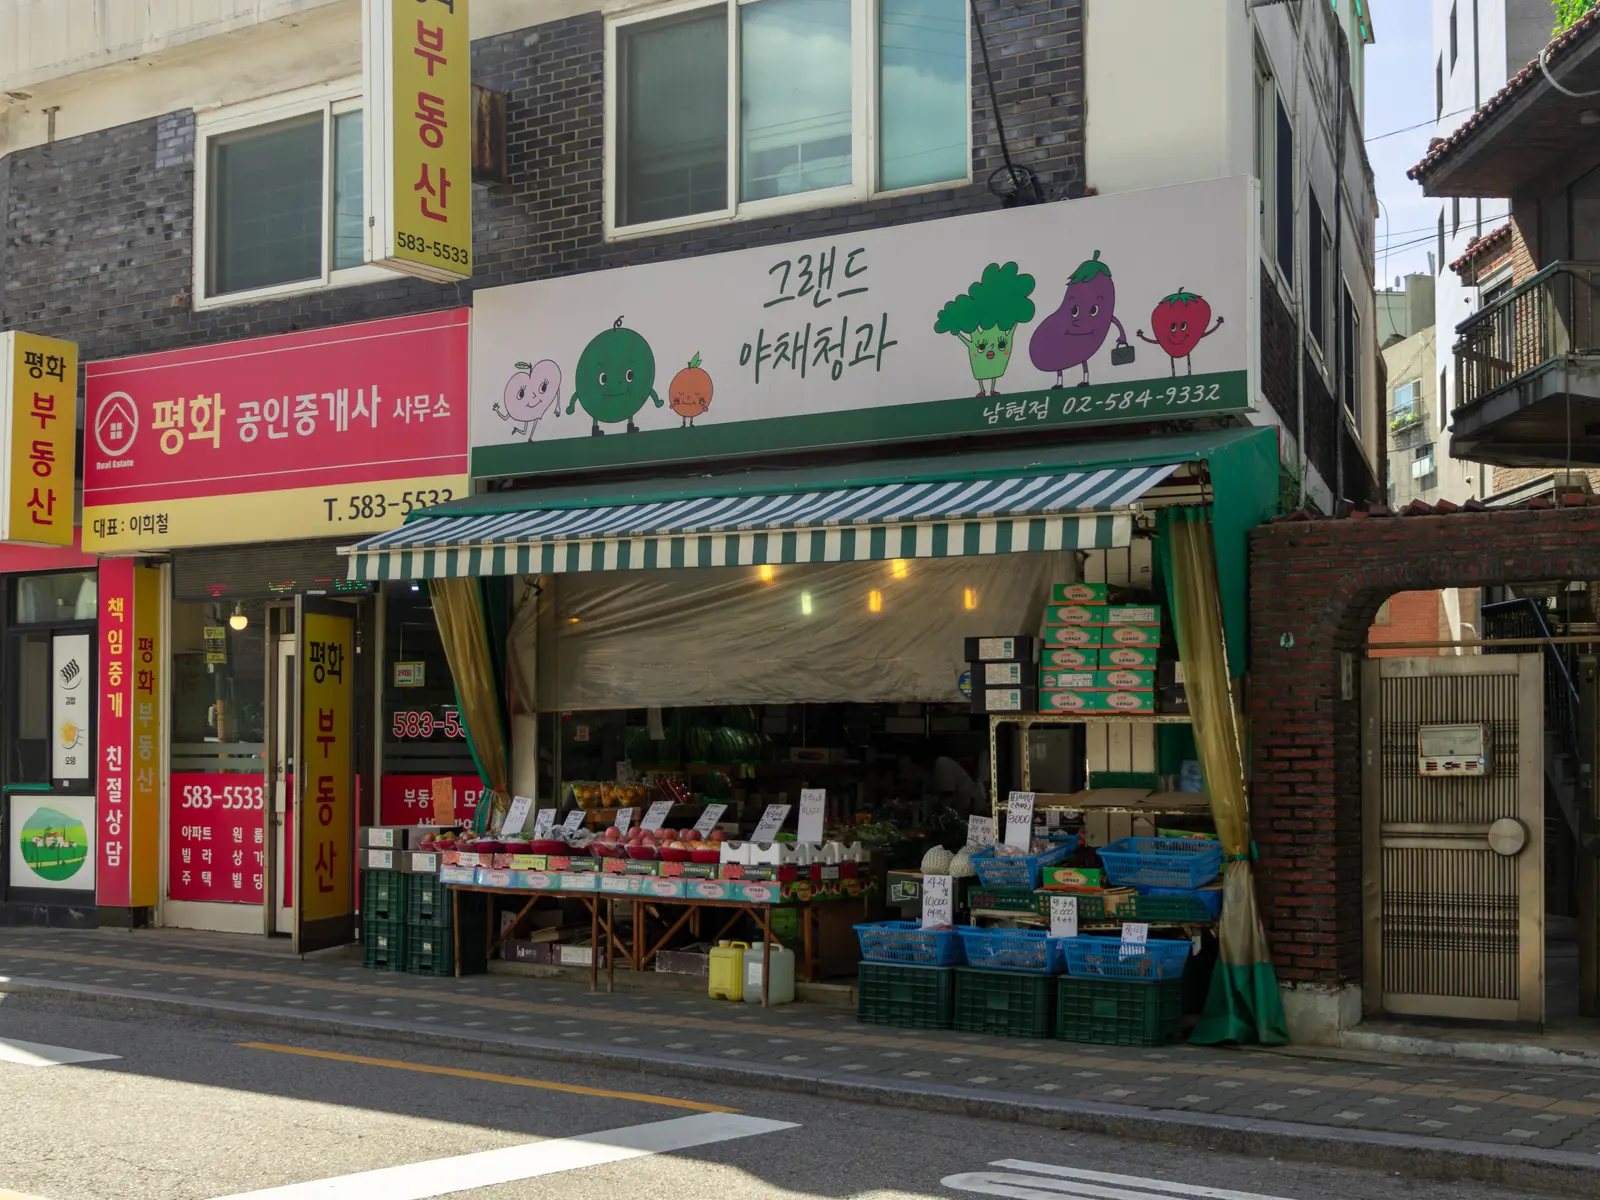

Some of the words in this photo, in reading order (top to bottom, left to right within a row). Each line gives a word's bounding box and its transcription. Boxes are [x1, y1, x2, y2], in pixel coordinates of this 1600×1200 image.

[413, 19, 452, 223] 부동산
[396, 231, 469, 265] 583-5533
[763, 245, 869, 308] 그랜드
[24, 351, 66, 382] 평화
[739, 312, 898, 384] 야채청과
[152, 393, 226, 455] 평화
[236, 385, 381, 442] 공인중개사
[393, 394, 450, 424] 사무소
[982, 396, 1050, 425] 남현점
[1062, 383, 1221, 415] 02-584-9332
[27, 392, 56, 526] 부동산
[96, 461, 112, 470] Real
[112, 459, 135, 469] Estate
[129, 513, 168, 535] 이희철
[323, 497, 342, 522] T.
[106, 597, 124, 718] 책임중개
[136, 637, 155, 696] 평화
[309, 641, 344, 685] 평화
[136, 702, 155, 794] 부동산
[105, 745, 123, 867] 친절상담
[181, 785, 264, 810] 583-5533
[314, 707, 337, 893] 부동산
[181, 825, 212, 841] 아파트
[181, 848, 212, 865] 빌라
[181, 870, 212, 887] 주택
